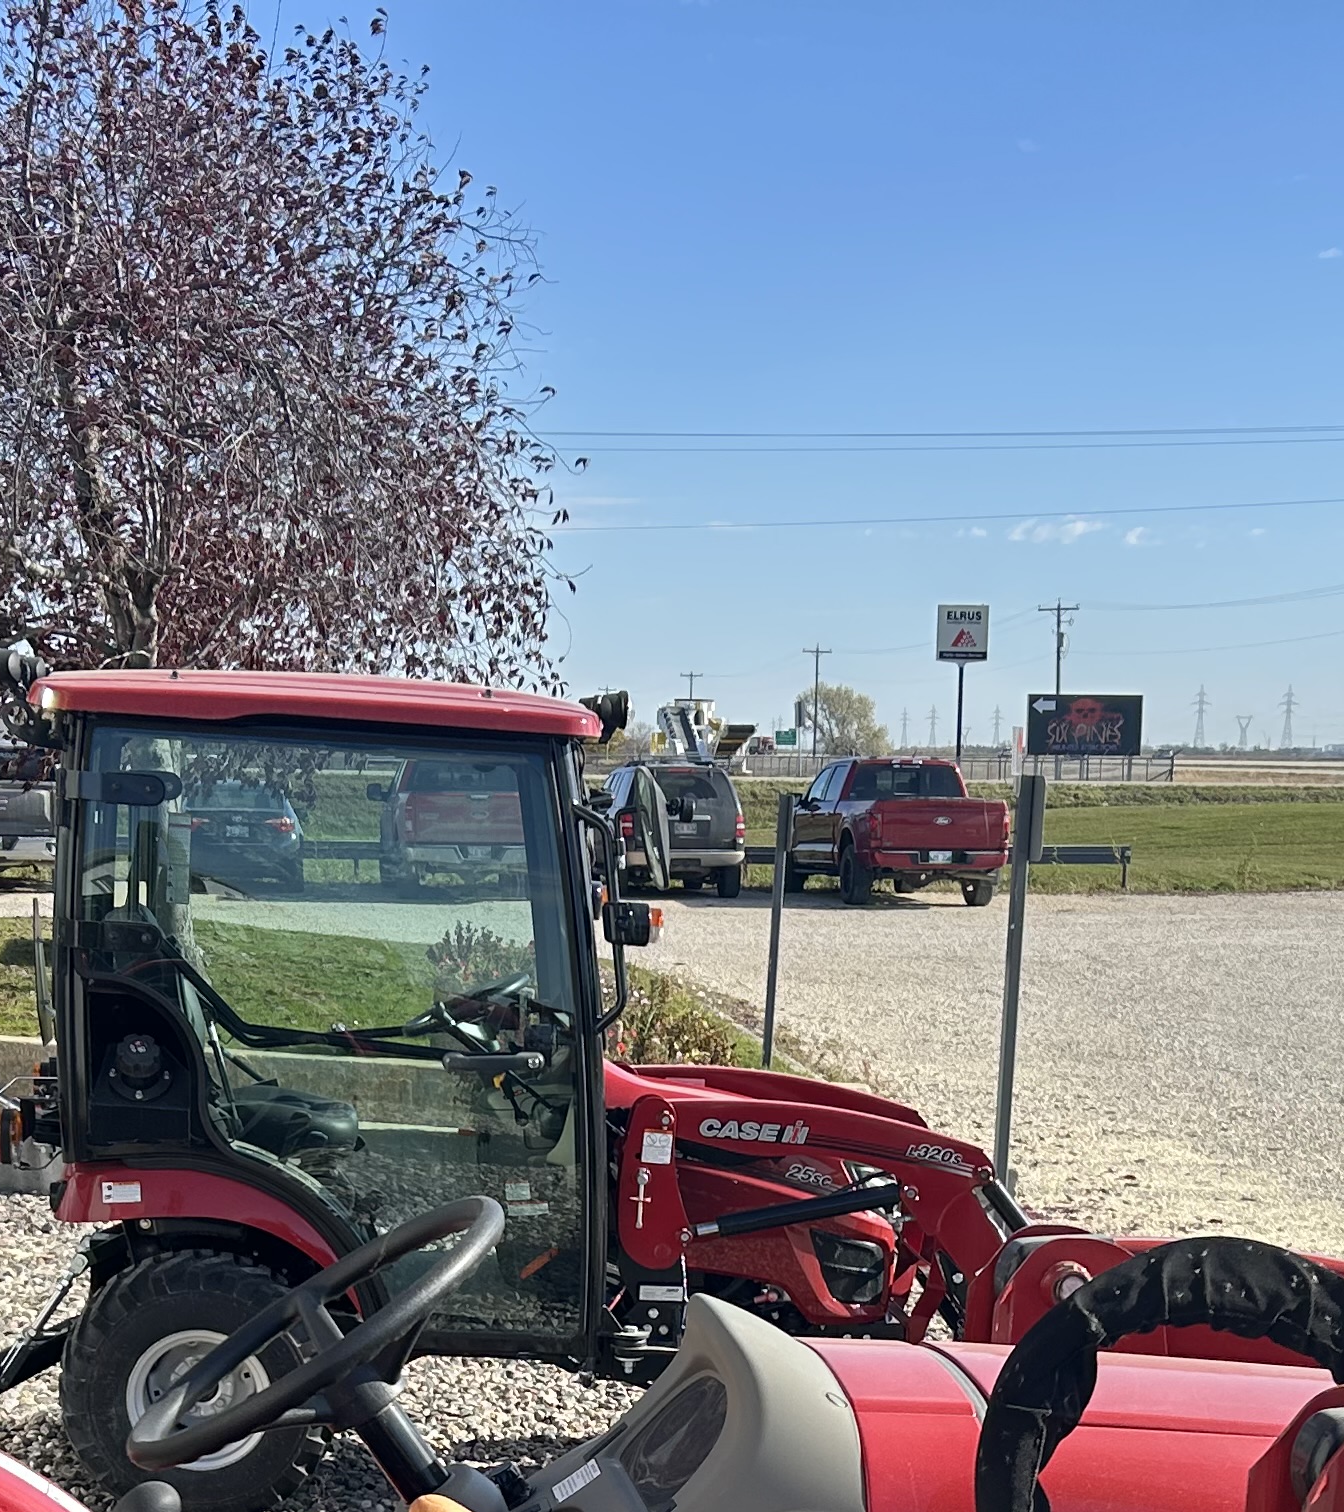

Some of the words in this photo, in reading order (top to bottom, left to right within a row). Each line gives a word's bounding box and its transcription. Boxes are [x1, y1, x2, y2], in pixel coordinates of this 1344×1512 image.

[946, 610, 982, 621] ELRUS
[1046, 720, 1069, 746] SIX
[1071, 714, 1125, 746] PINES
[699, 1118, 781, 1142] CASE
